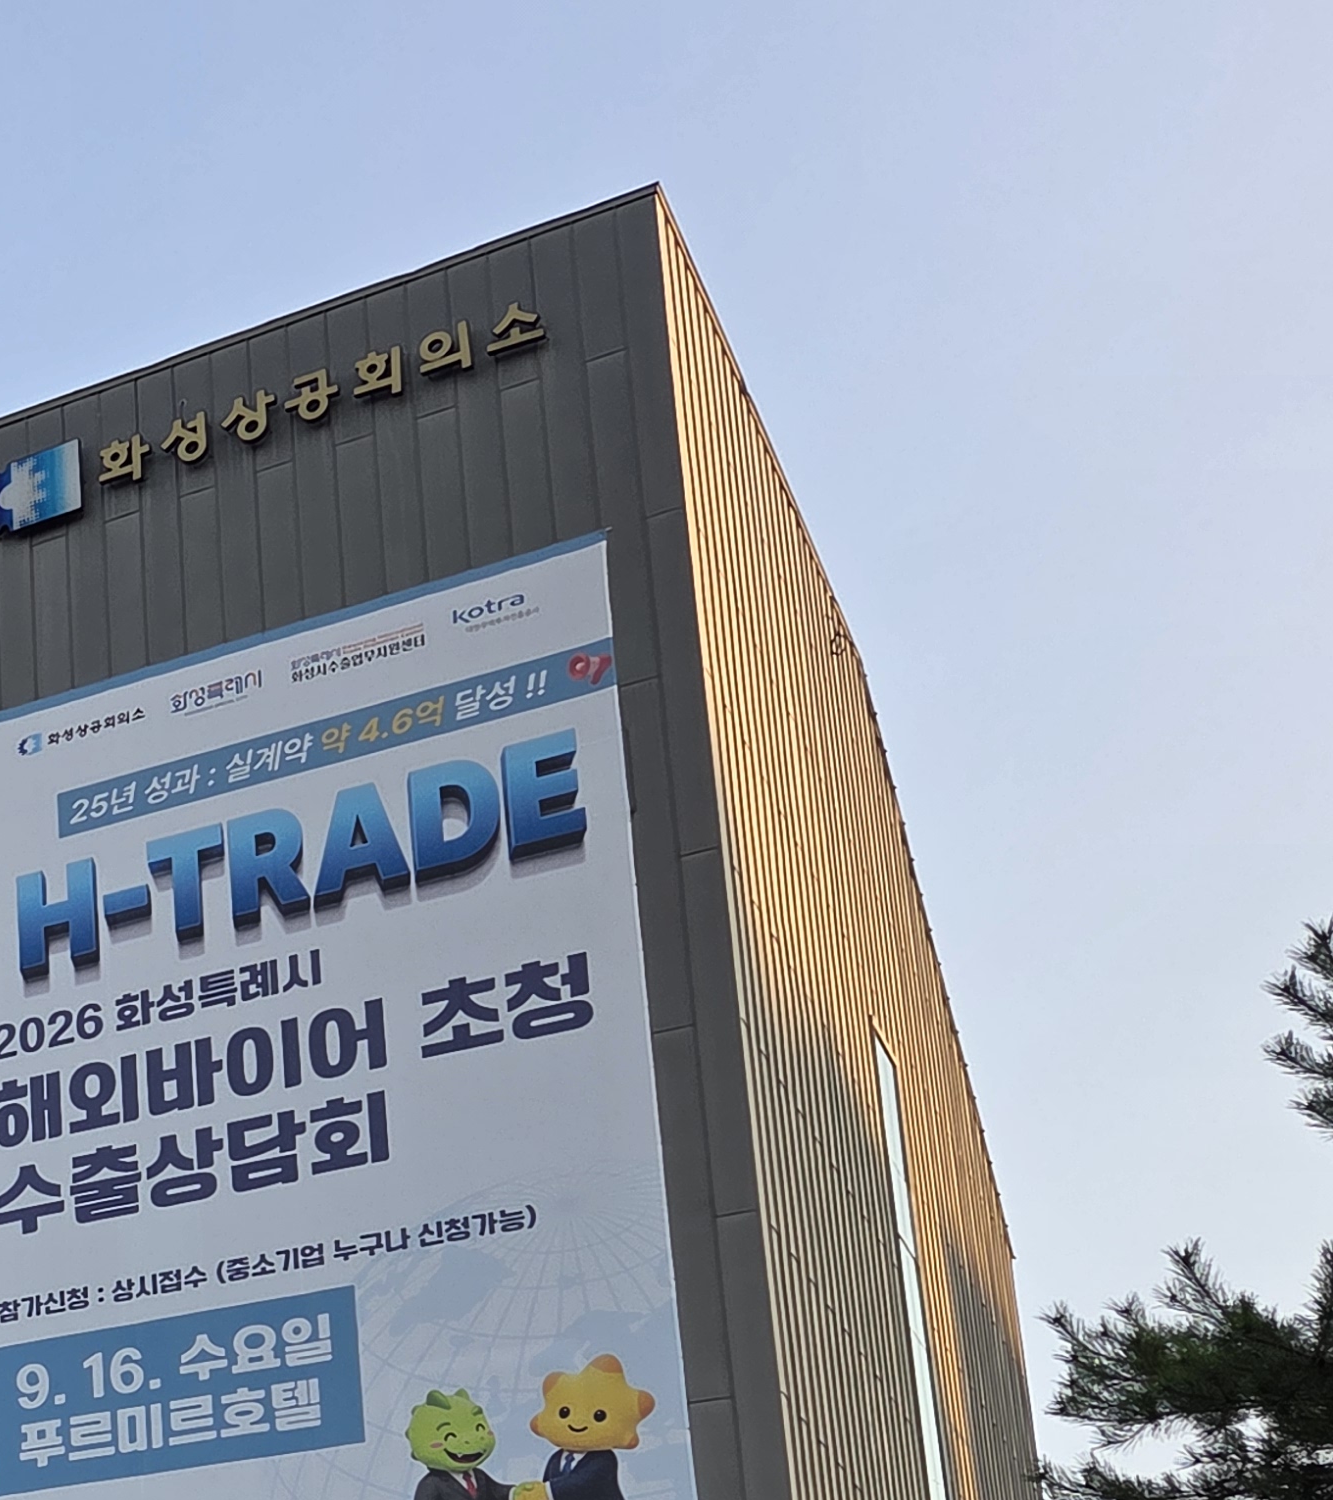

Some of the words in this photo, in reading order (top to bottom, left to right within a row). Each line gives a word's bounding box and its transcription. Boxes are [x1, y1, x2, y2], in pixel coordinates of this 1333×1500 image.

[98, 302, 546, 486] 화성상공회의소
[452, 594, 525, 625] kotra
[46, 707, 146, 746] 화성상공회의소
[170, 669, 262, 714] 화성특례시
[68, 782, 140, 827] 25년
[143, 761, 202, 807] 성과
[225, 731, 315, 785] 실계약
[320, 723, 352, 755] 약
[357, 695, 446, 744] 4.6억
[453, 675, 517, 722] 달성
[524, 670, 549, 699] !!
[15, 727, 588, 982] H-TRADE
[114, 948, 323, 1034] 화성특례시
[419, 951, 596, 1060] 초청
[111, 1265, 208, 1304] 상시접수
[215, 1243, 326, 1286] (중소기업
[333, 1221, 411, 1262] 누구나
[417, 1203, 538, 1249] 신청가능)
[14, 1361, 67, 1411] 9.
[83, 1347, 162, 1400] 16.
[178, 1313, 334, 1382] 수요일
[18, 1377, 322, 1468] 푸르미르호텔
